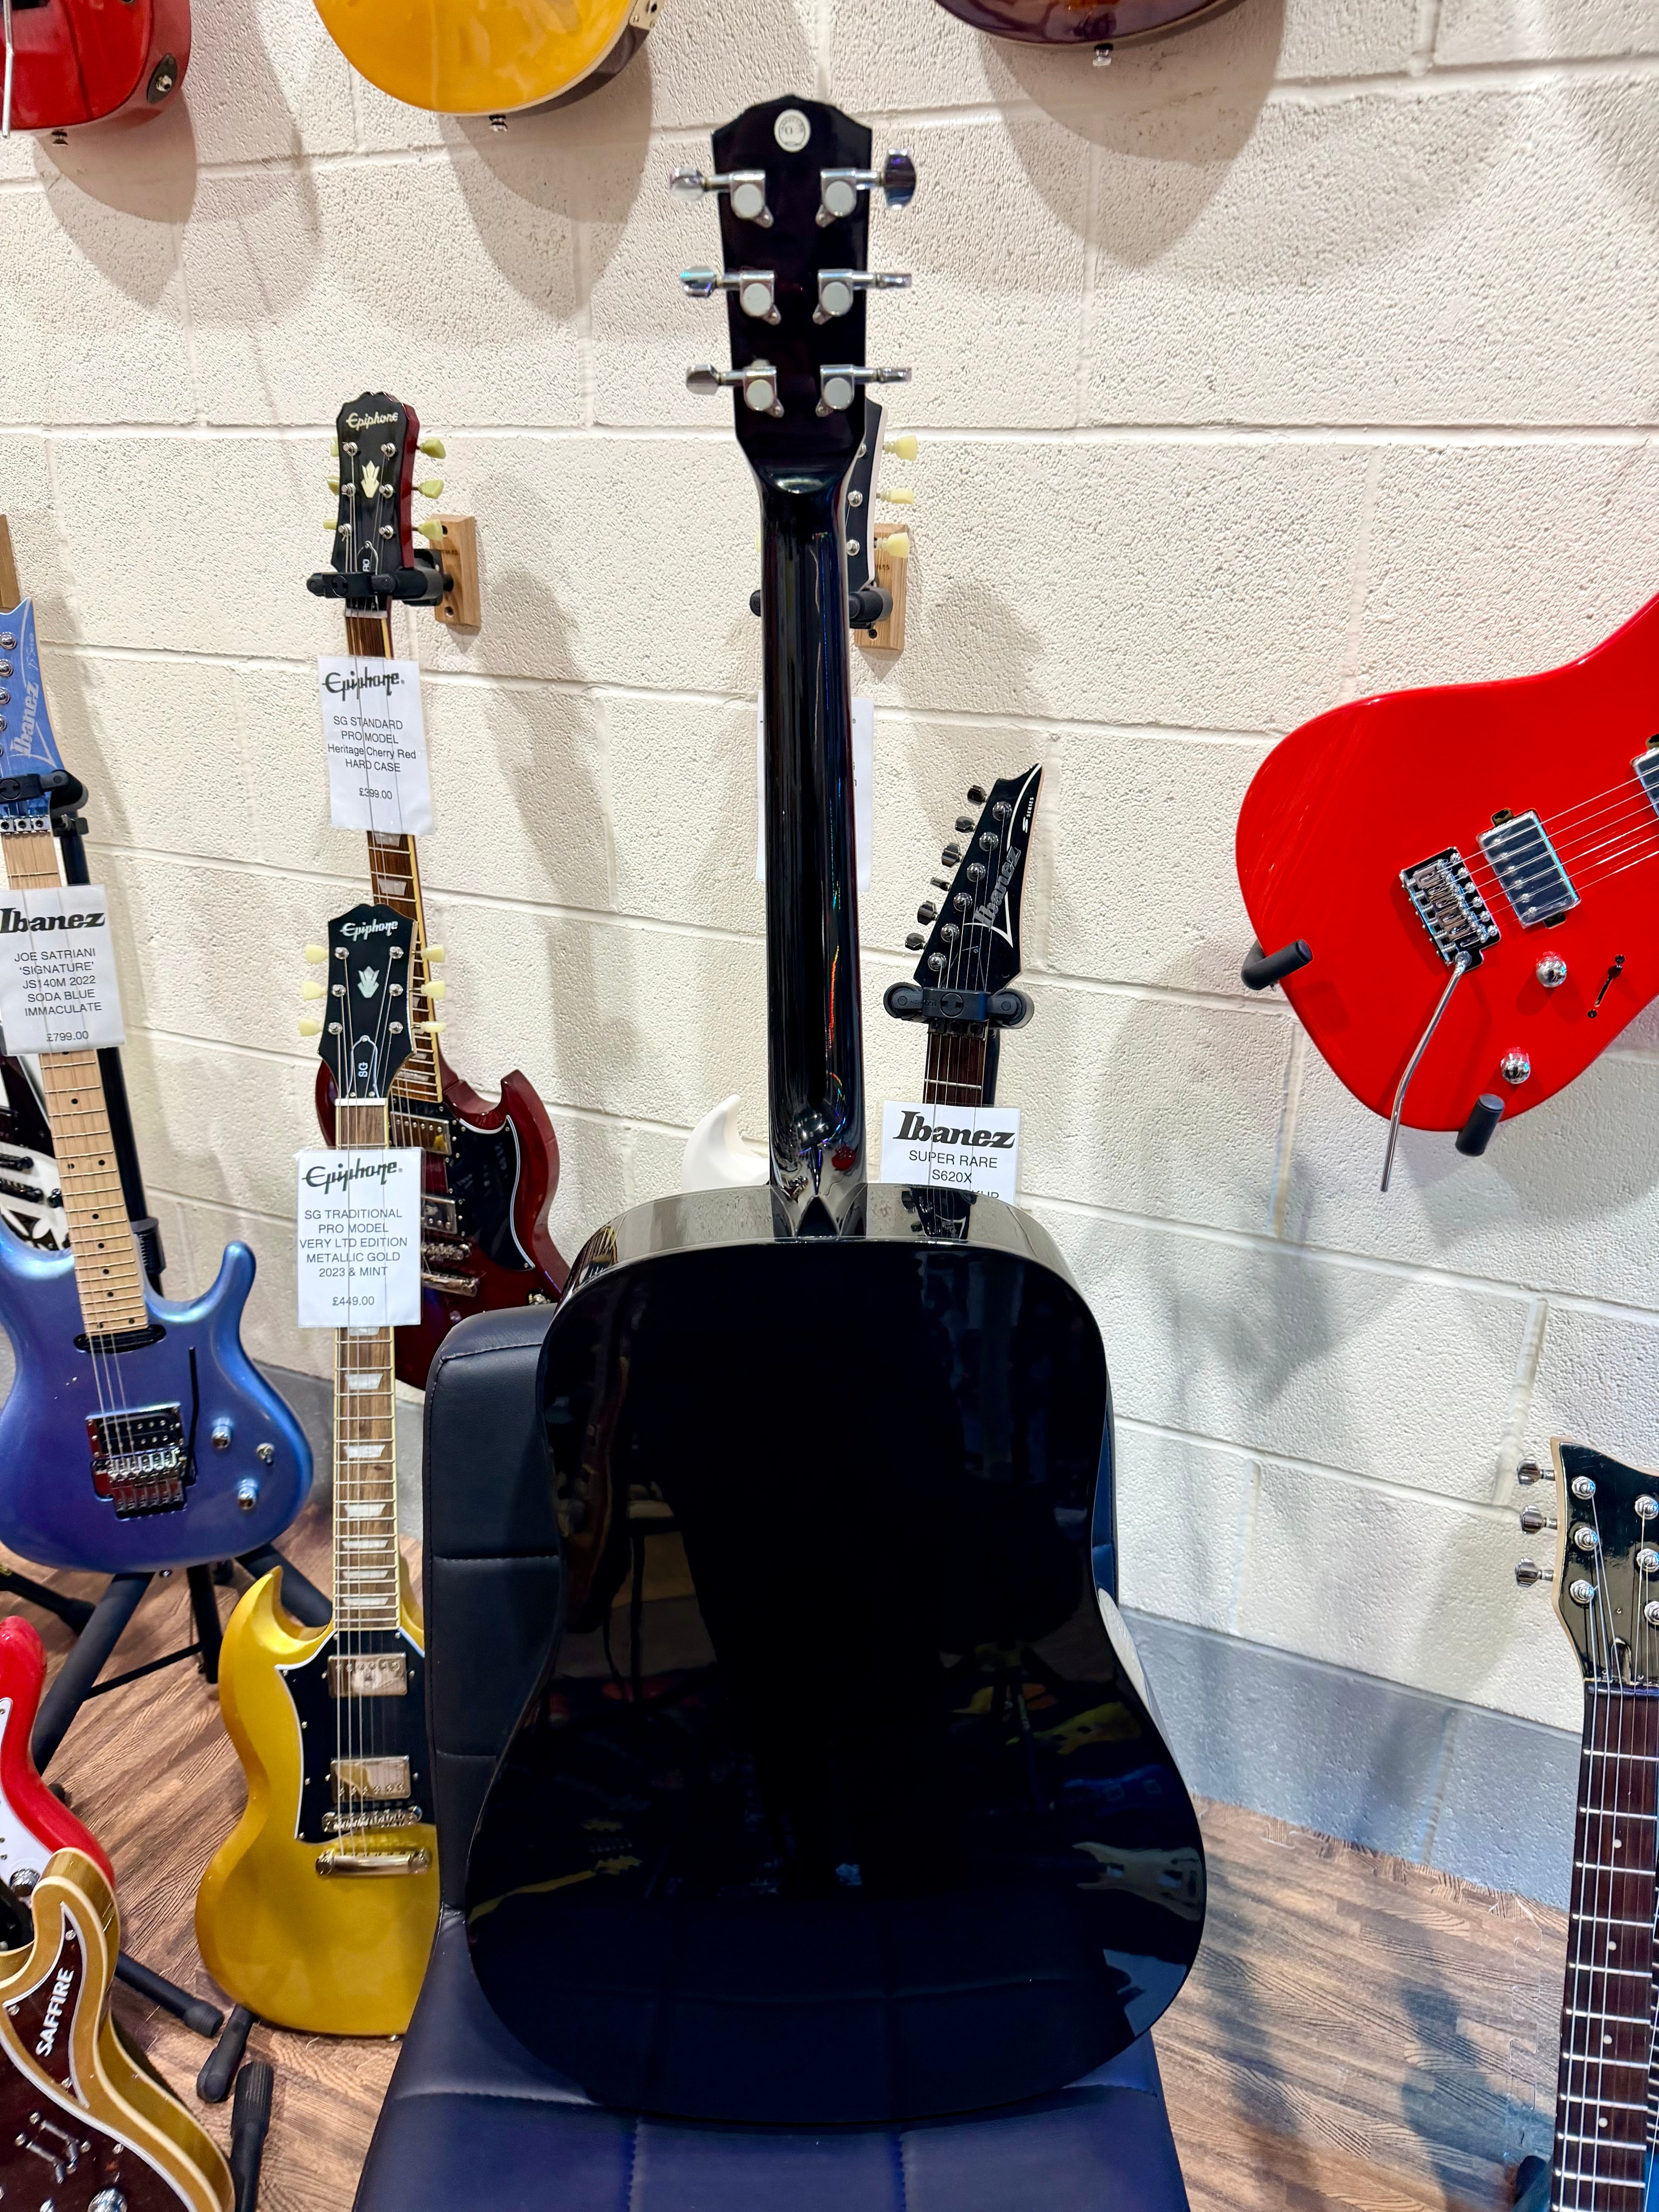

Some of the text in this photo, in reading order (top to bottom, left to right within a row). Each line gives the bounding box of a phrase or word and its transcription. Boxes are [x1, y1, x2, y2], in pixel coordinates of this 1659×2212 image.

[346, 412, 398, 431] Epiphone
[322, 666, 400, 701] Epiphone
[10, 681, 39, 758] Ibanez
[334, 716, 403, 730] SG STANDARD
[342, 731, 399, 744] PRO MODEL
[328, 744, 416, 759] Heritage Cherry Red
[346, 759, 401, 772] HARD CASE
[359, 788, 392, 800] £399.00
[972, 846, 1021, 933] Ibanez
[0, 907, 105, 933] Ibanez
[340, 919, 398, 941] Epiphone
[15, 948, 95, 962] JOE SATRIANI
[23, 975, 96, 989] JS140M 2022
[28, 989, 95, 1002] SODA BLUE
[25, 1002, 102, 1016] IMMACULATE
[47, 1030, 89, 1042] £799.00
[358, 1062, 368, 1078] SG
[893, 1110, 1015, 1149] Ibanez
[909, 1150, 997, 1168] SUPER RARE
[302, 1158, 398, 1194] Epiphone
[932, 1169, 972, 1183] S620X
[305, 1209, 402, 1219] SG TRADITIONAL
[319, 1223, 389, 1233] PRO MODEL
[300, 1237, 407, 1249] VERY LTD EDITION
[307, 1252, 400, 1263] METALLIC GOLD
[319, 1266, 388, 1277] 2023 & MINT
[332, 1296, 374, 1306] £449.00
[36, 1967, 74, 2057] SAFFIRE
